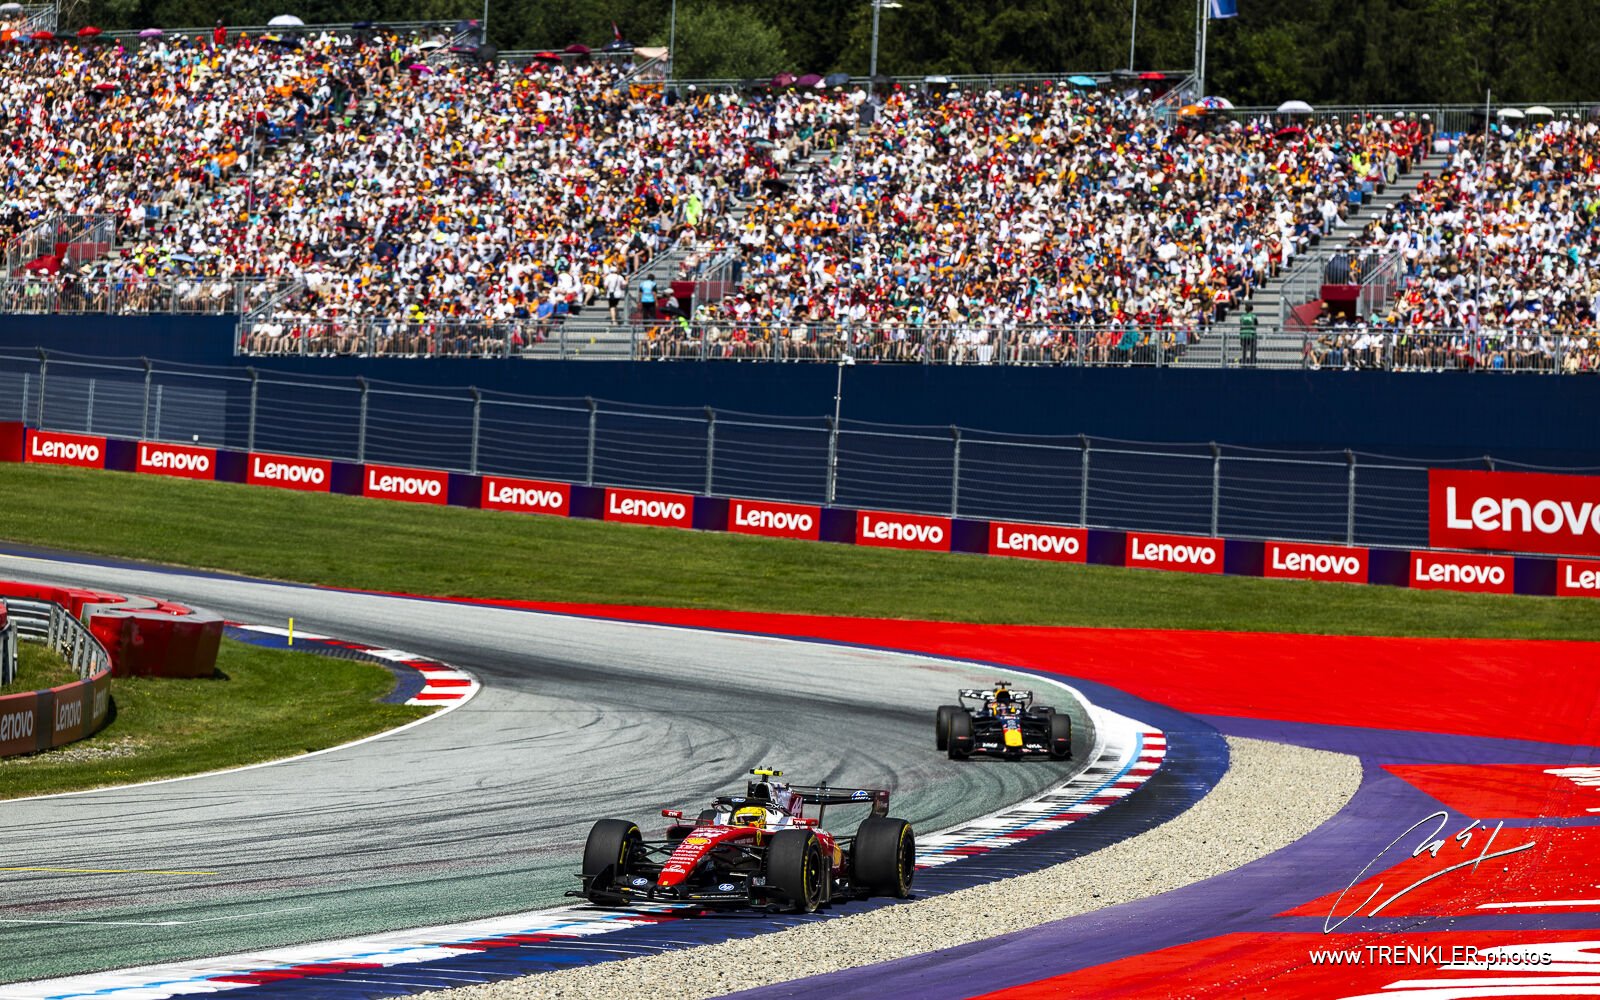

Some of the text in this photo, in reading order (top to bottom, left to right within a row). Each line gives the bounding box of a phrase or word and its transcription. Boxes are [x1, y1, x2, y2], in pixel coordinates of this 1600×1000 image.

[32, 436, 99, 462] Lenovo
[141, 445, 210, 472] Lenovo
[253, 457, 325, 484] Lenovo
[368, 469, 442, 497] Lenovo
[488, 481, 563, 508] Lenovo
[609, 493, 686, 520] Lenovo
[735, 504, 813, 532] Lenovo
[862, 516, 944, 544] Lenovo
[996, 527, 1080, 555] Lenovo
[1131, 537, 1216, 565] Lenovo
[1272, 547, 1360, 575] Lenovo
[1415, 558, 1505, 585] Lenovo
[0, 709, 34, 741] enovo
[55, 698, 82, 732] Lenovo
